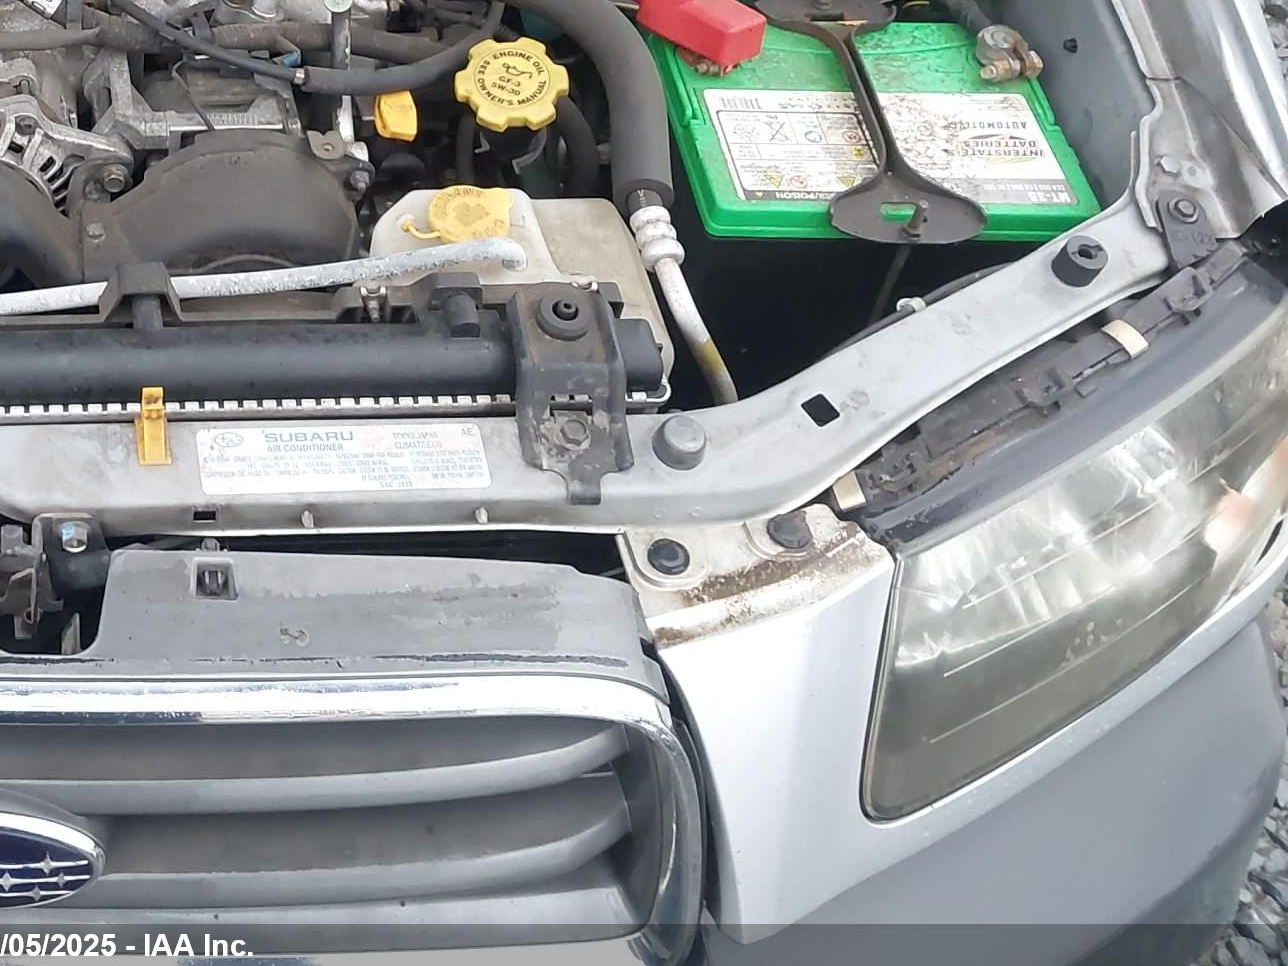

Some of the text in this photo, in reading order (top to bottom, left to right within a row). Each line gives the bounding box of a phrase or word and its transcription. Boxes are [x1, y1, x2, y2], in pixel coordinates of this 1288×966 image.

[493, 50, 546, 77] ENGINE OIL
[477, 59, 547, 106] SEE OWNER'S MANUAL
[491, 82, 521, 96] 5W-30
[962, 139, 1037, 148] BATTERIES
[960, 148, 1046, 158] INTERSTATE
[264, 430, 354, 442] SUBARU
[267, 442, 344, 452] AIR CONDITIONER
